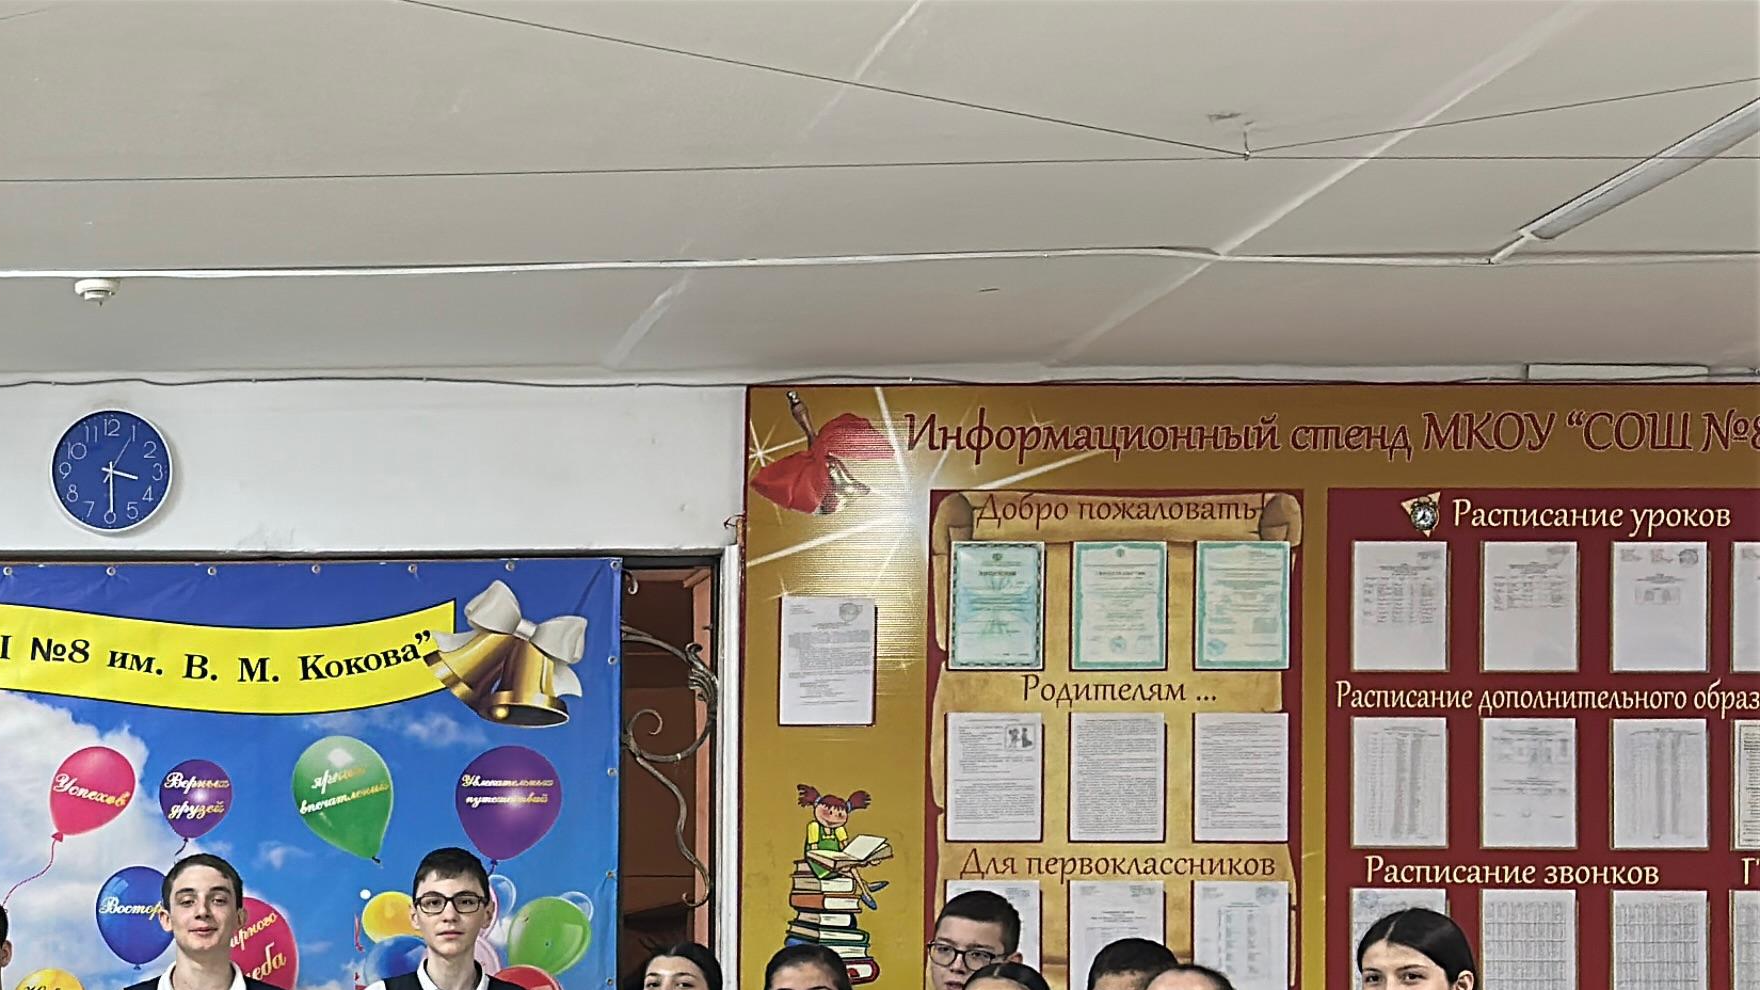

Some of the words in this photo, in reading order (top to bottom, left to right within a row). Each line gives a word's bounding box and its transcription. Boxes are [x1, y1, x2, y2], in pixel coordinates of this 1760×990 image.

[85, 425, 98, 443] 11
[104, 418, 121, 437] 12
[904, 407, 1281, 465] Информационный
[1291, 422, 1412, 461] стенд
[1422, 411, 1556, 453] МКОУ
[67, 442, 87, 460] 10
[144, 441, 157, 458] 2
[59, 462, 72, 479] 9
[152, 463, 163, 481] 3
[67, 484, 78, 503] 8
[142, 485, 154, 502] 4
[84, 501, 95, 517] 7
[126, 502, 138, 519] 5
[977, 496, 1069, 532] Добро
[1077, 499, 1258, 524] пожаловать
[1452, 499, 1624, 528] Расписание
[1629, 506, 1731, 537] уроков
[30, 637, 90, 664] №8
[107, 649, 163, 675] им.
[183, 653, 217, 682] В.
[237, 658, 279, 682] М.
[1022, 674, 1186, 703] Родителям
[1336, 680, 1473, 709] Расписание
[1477, 688, 1687, 715] дополнительного
[960, 848, 1018, 880] Для
[1025, 853, 1276, 881] первоклассников
[1364, 855, 1536, 884] Расписание
[1543, 863, 1659, 885] звонков
[99, 896, 162, 921] Востор
[230, 912, 278, 950] ирного
[246, 942, 287, 981] еба
